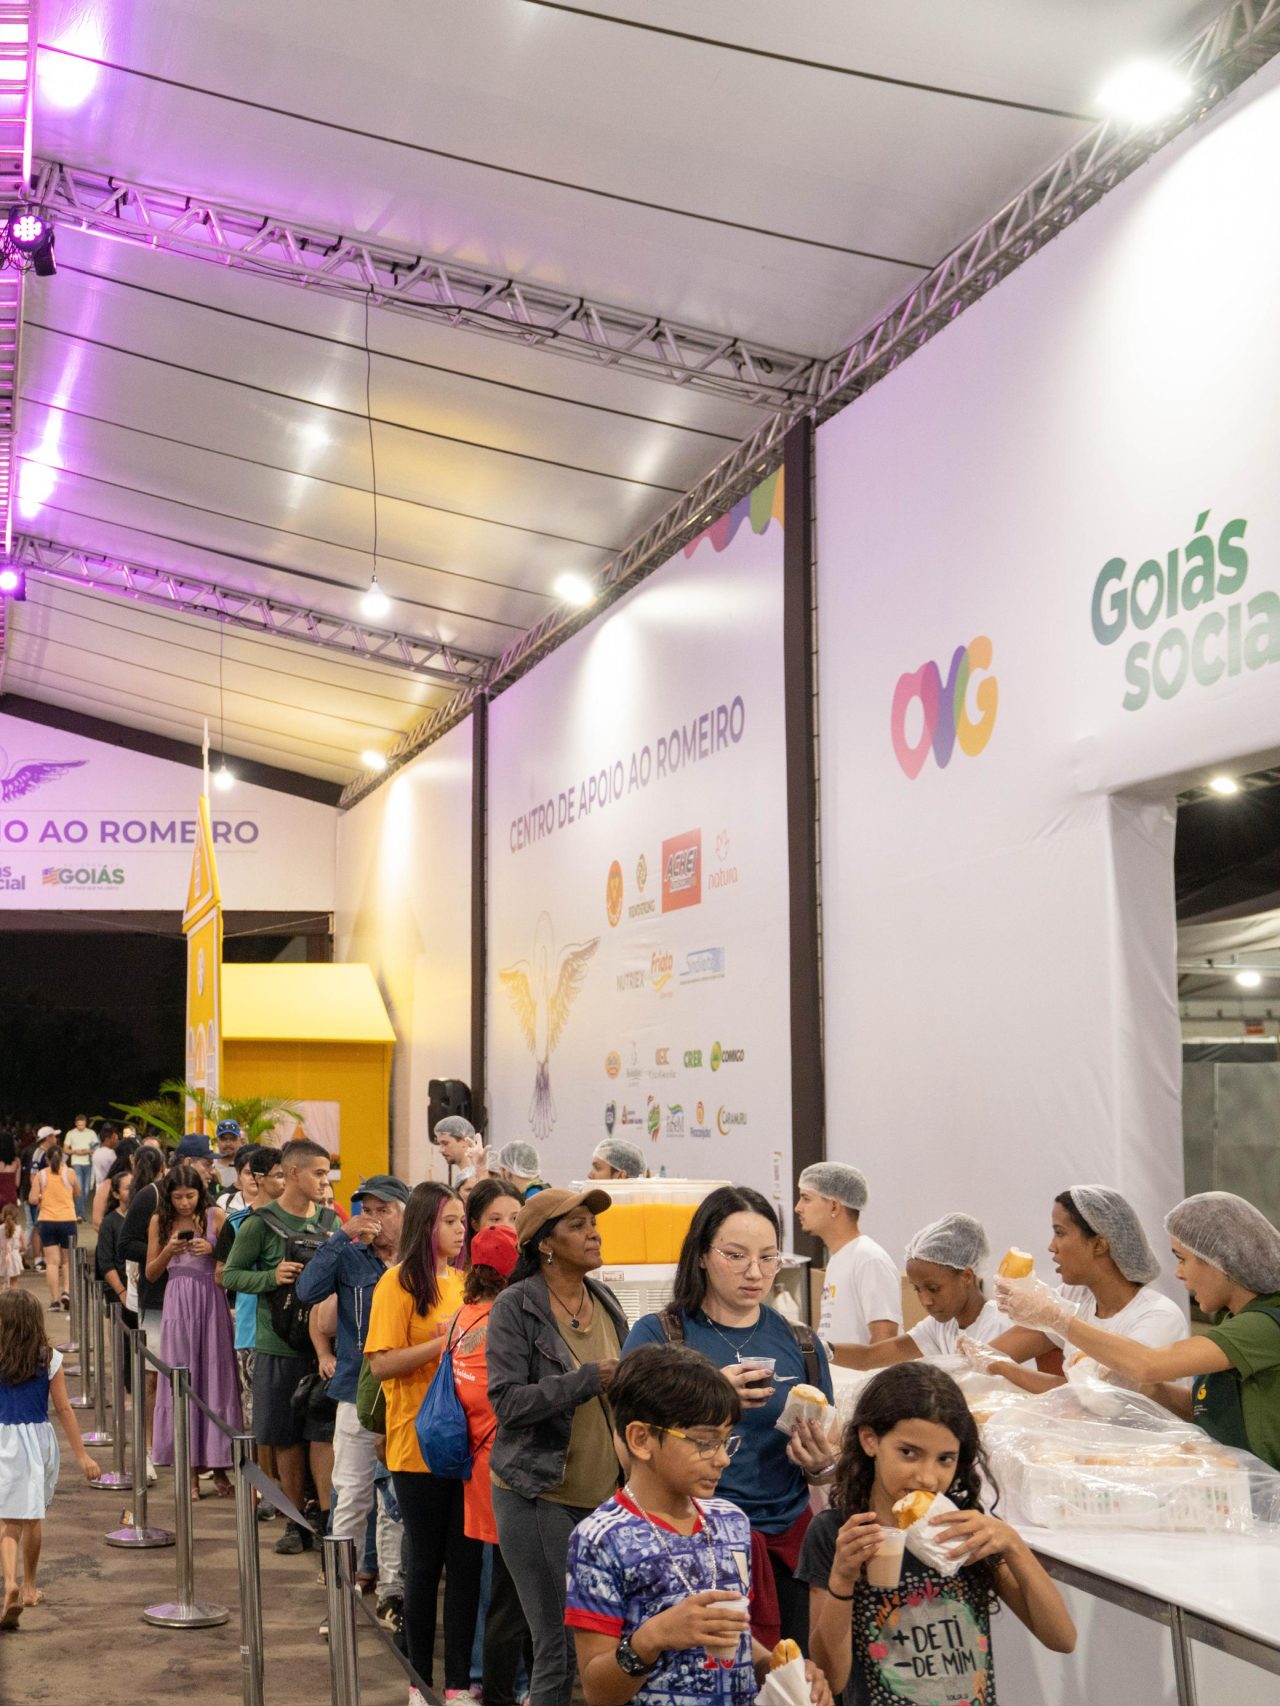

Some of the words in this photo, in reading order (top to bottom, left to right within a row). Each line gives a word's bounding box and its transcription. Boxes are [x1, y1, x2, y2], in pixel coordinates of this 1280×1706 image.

[1091, 508, 1248, 646] Goiás
[1122, 591, 1280, 712] socia
[510, 798, 555, 854] CENTRO
[558, 786, 575, 830] DE
[577, 760, 624, 820] APOIO
[627, 745, 652, 794] AO
[656, 695, 745, 780] ROMEIRO
[39, 820, 88, 843] AO
[100, 820, 259, 844] ROMERO
[59, 865, 125, 884] GOIÁS
[912, 1655, 937, 1678] DE
